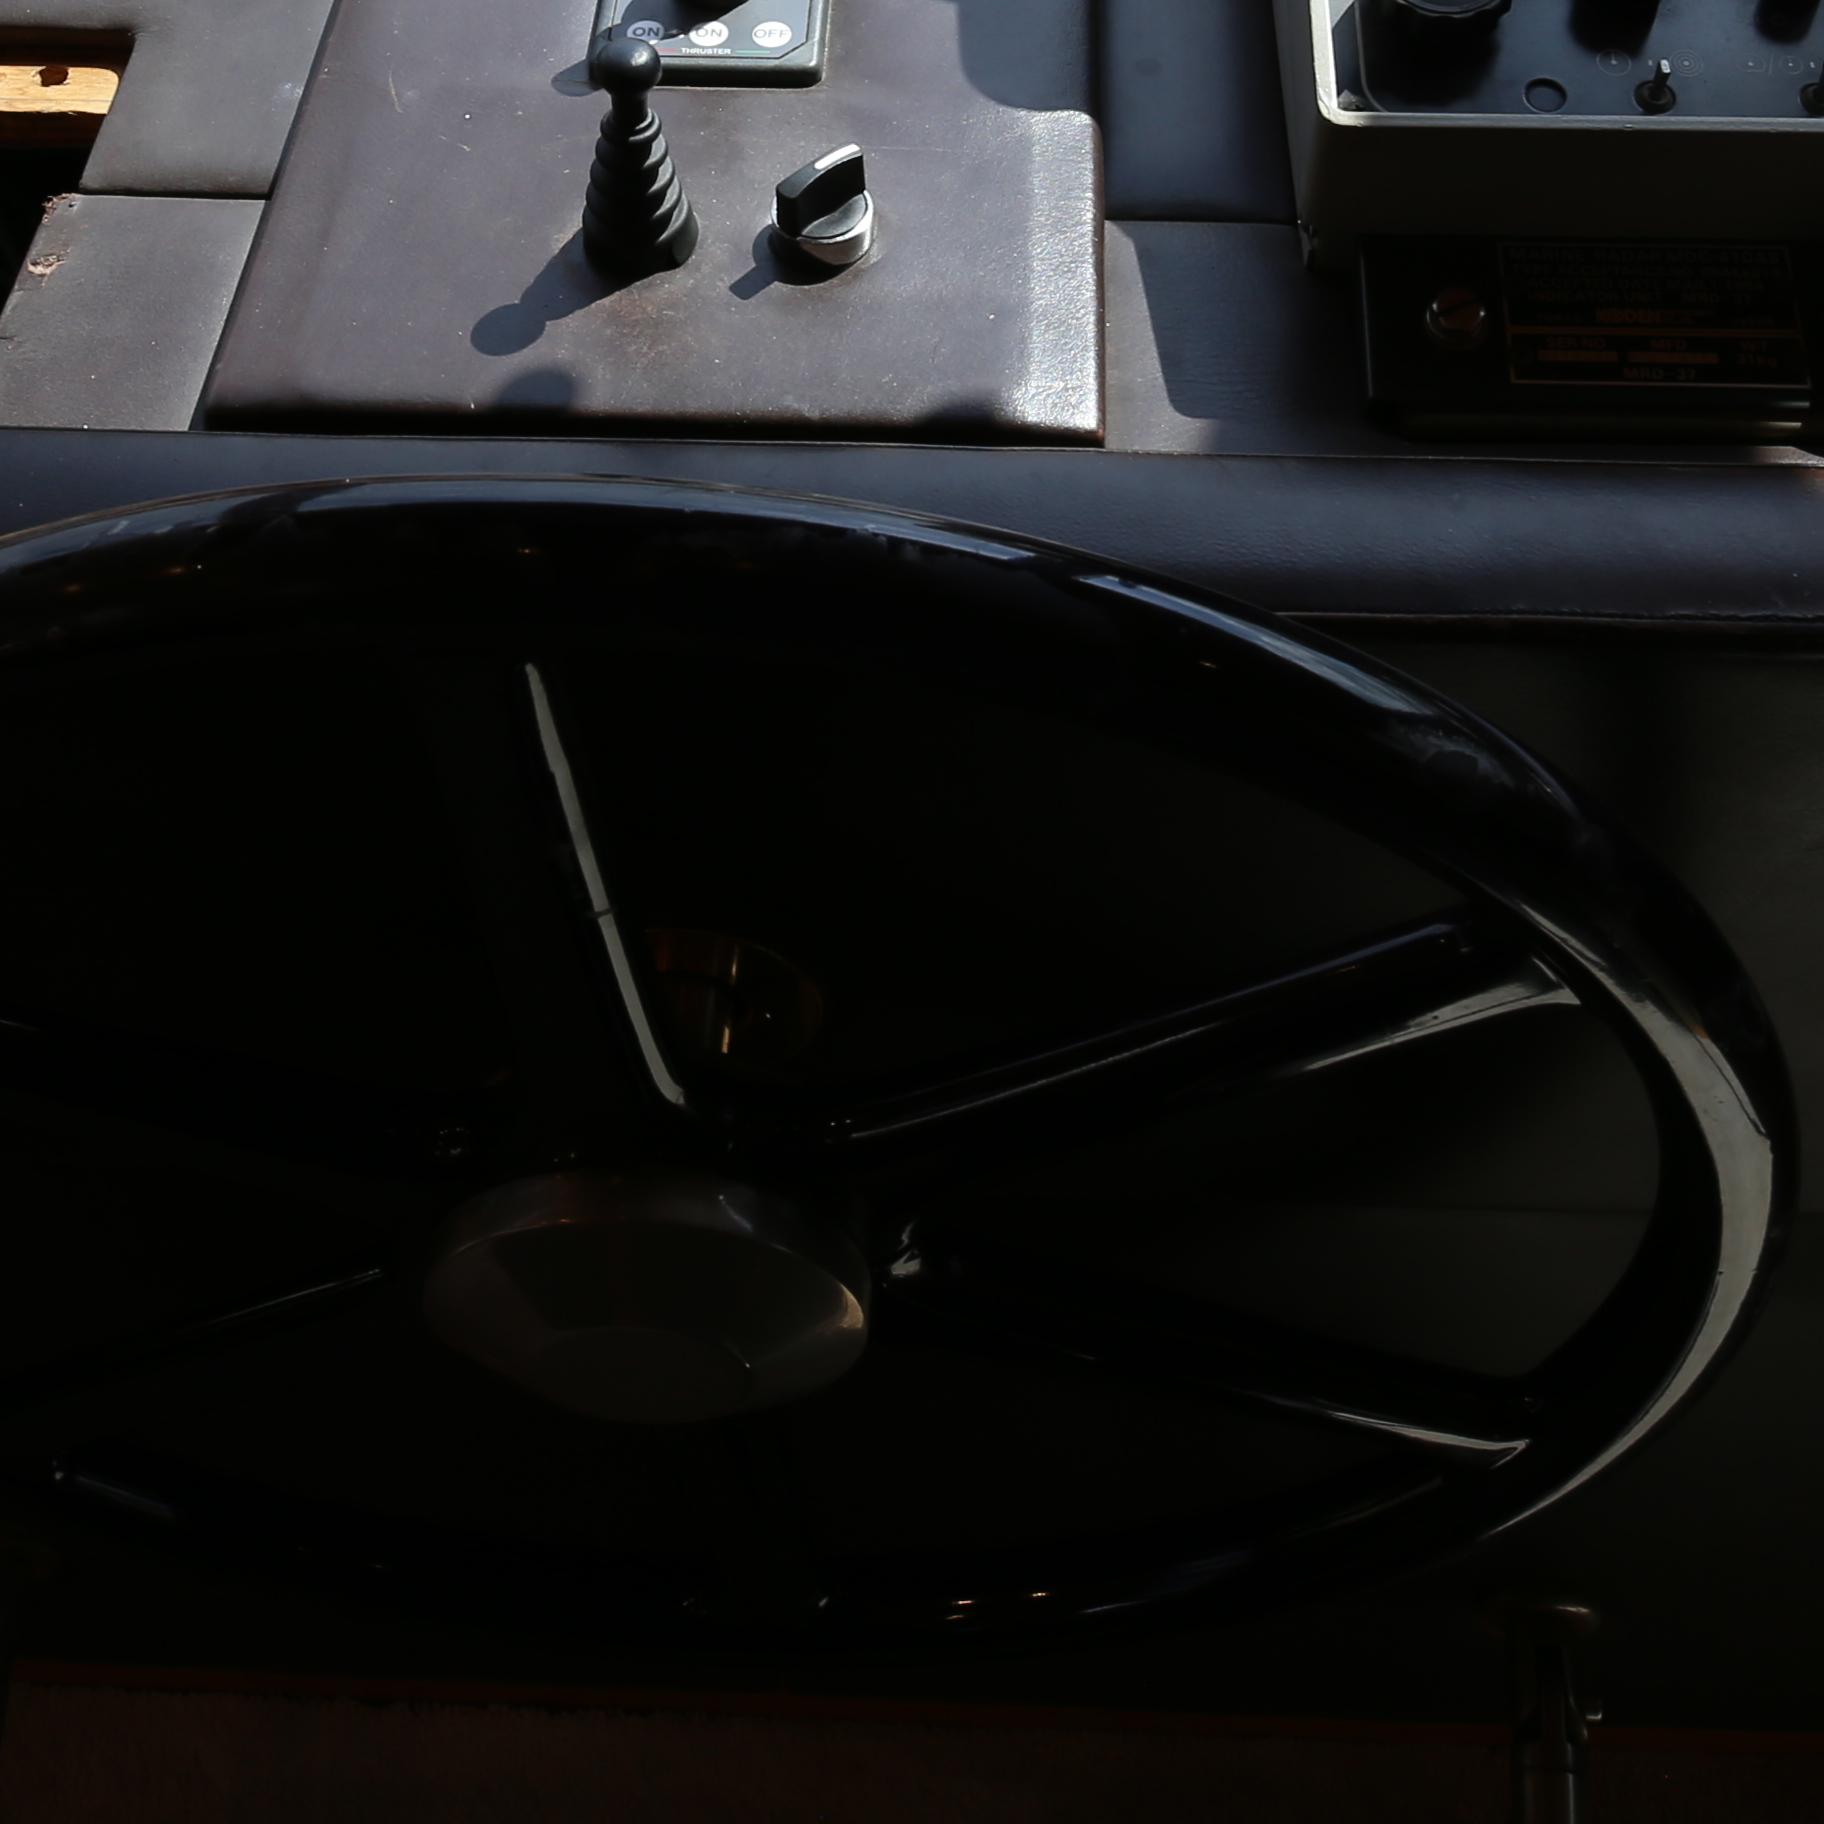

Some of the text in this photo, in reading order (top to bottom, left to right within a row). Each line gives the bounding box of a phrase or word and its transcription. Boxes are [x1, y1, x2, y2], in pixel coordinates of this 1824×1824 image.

[631, 27, 661, 36] ON
[695, 28, 723, 37] ON
[753, 29, 786, 38] OFF
[681, 47, 732, 55] THRUSTER
